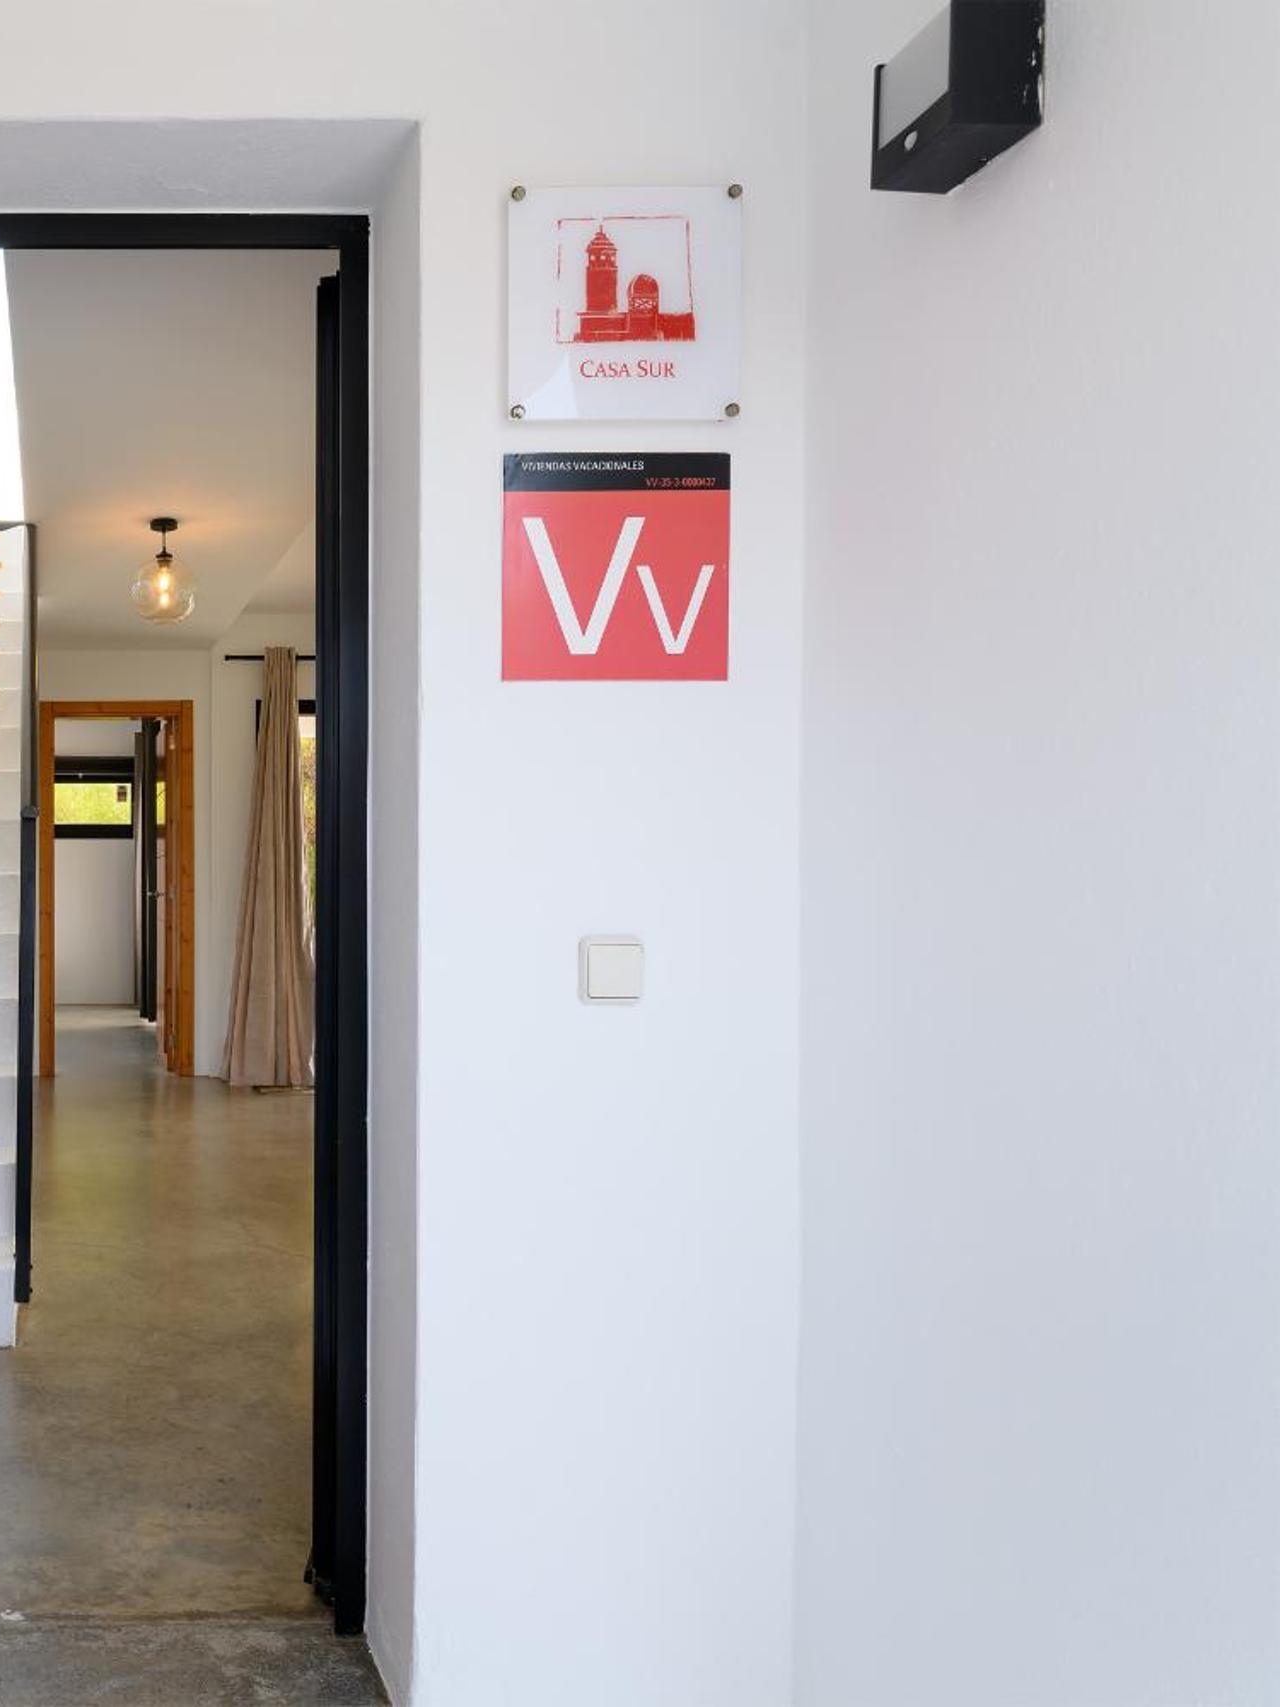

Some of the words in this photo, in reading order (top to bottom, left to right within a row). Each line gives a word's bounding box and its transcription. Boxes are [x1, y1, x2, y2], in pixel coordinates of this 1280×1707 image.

[580, 359, 630, 378] CASA
[637, 359, 676, 378] SUR
[521, 461, 572, 471] VIVIENDAS
[573, 461, 645, 471] VACACIONALES
